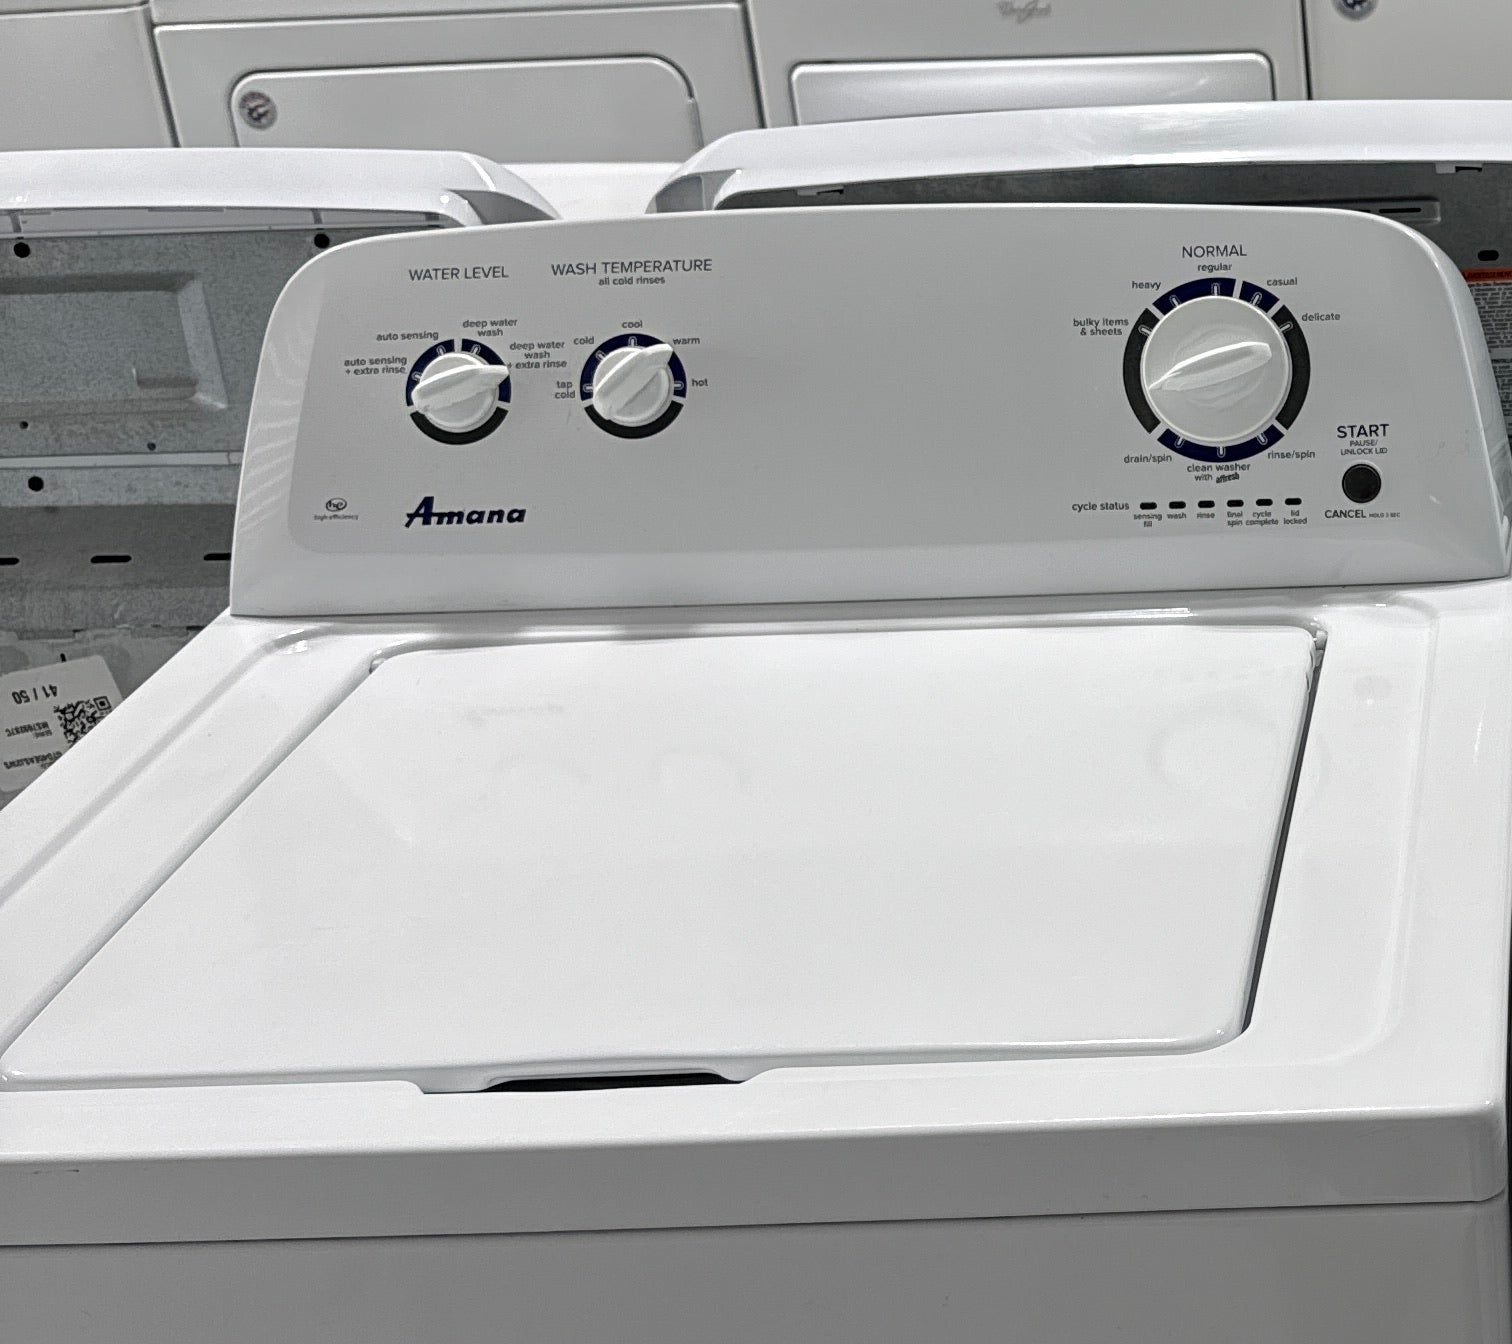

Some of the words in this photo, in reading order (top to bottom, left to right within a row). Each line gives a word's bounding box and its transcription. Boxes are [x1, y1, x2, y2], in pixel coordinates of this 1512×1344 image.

[1182, 245, 1247, 258] NORMAL
[551, 263, 597, 276] WASH
[602, 259, 713, 274] TEMPERATURE
[1197, 262, 1233, 273] regular
[408, 267, 460, 281] WATER
[464, 266, 509, 280] LEVEL
[612, 276, 634, 285] cold
[636, 275, 666, 285] rinses
[1266, 277, 1298, 287] casual
[1131, 280, 1161, 291] heavy
[1301, 312, 1341, 322] delicate
[462, 320, 488, 329] deep
[490, 319, 518, 328] water
[621, 320, 643, 329] cool
[1073, 317, 1100, 329] bulky
[1102, 317, 1129, 327] items
[376, 333, 399, 341] auto
[400, 330, 439, 341] sensing
[477, 328, 504, 337] wash
[1080, 327, 1088, 336] &
[1090, 326, 1123, 336] sheets
[573, 336, 595, 345] cold
[672, 337, 701, 345] warm
[509, 342, 535, 351] deep
[537, 341, 565, 349] water
[524, 351, 550, 359] wash
[344, 358, 367, 366] auto
[369, 356, 407, 367] sensing
[515, 361, 541, 369] extra
[543, 359, 568, 368] rinse
[353, 367, 379, 375] extra
[381, 365, 406, 374] rinse
[556, 380, 573, 391] tap
[691, 378, 709, 387] hot
[555, 390, 576, 399] cold
[1337, 424, 1389, 438] START
[1267, 450, 1315, 461] rinse/spin
[1341, 448, 1373, 456] UNLOCK
[1124, 454, 1172, 464] drain/spin
[1187, 464, 1213, 473] clean
[1215, 463, 1251, 472] washer
[1195, 473, 1213, 482] with
[404, 495, 527, 528] Amana
[1071, 502, 1098, 513] cycle
[1099, 502, 1130, 511] status
[1325, 509, 1366, 519] CANCEL
[42, 684, 58, 698] 41
[11, 689, 31, 705] 50
